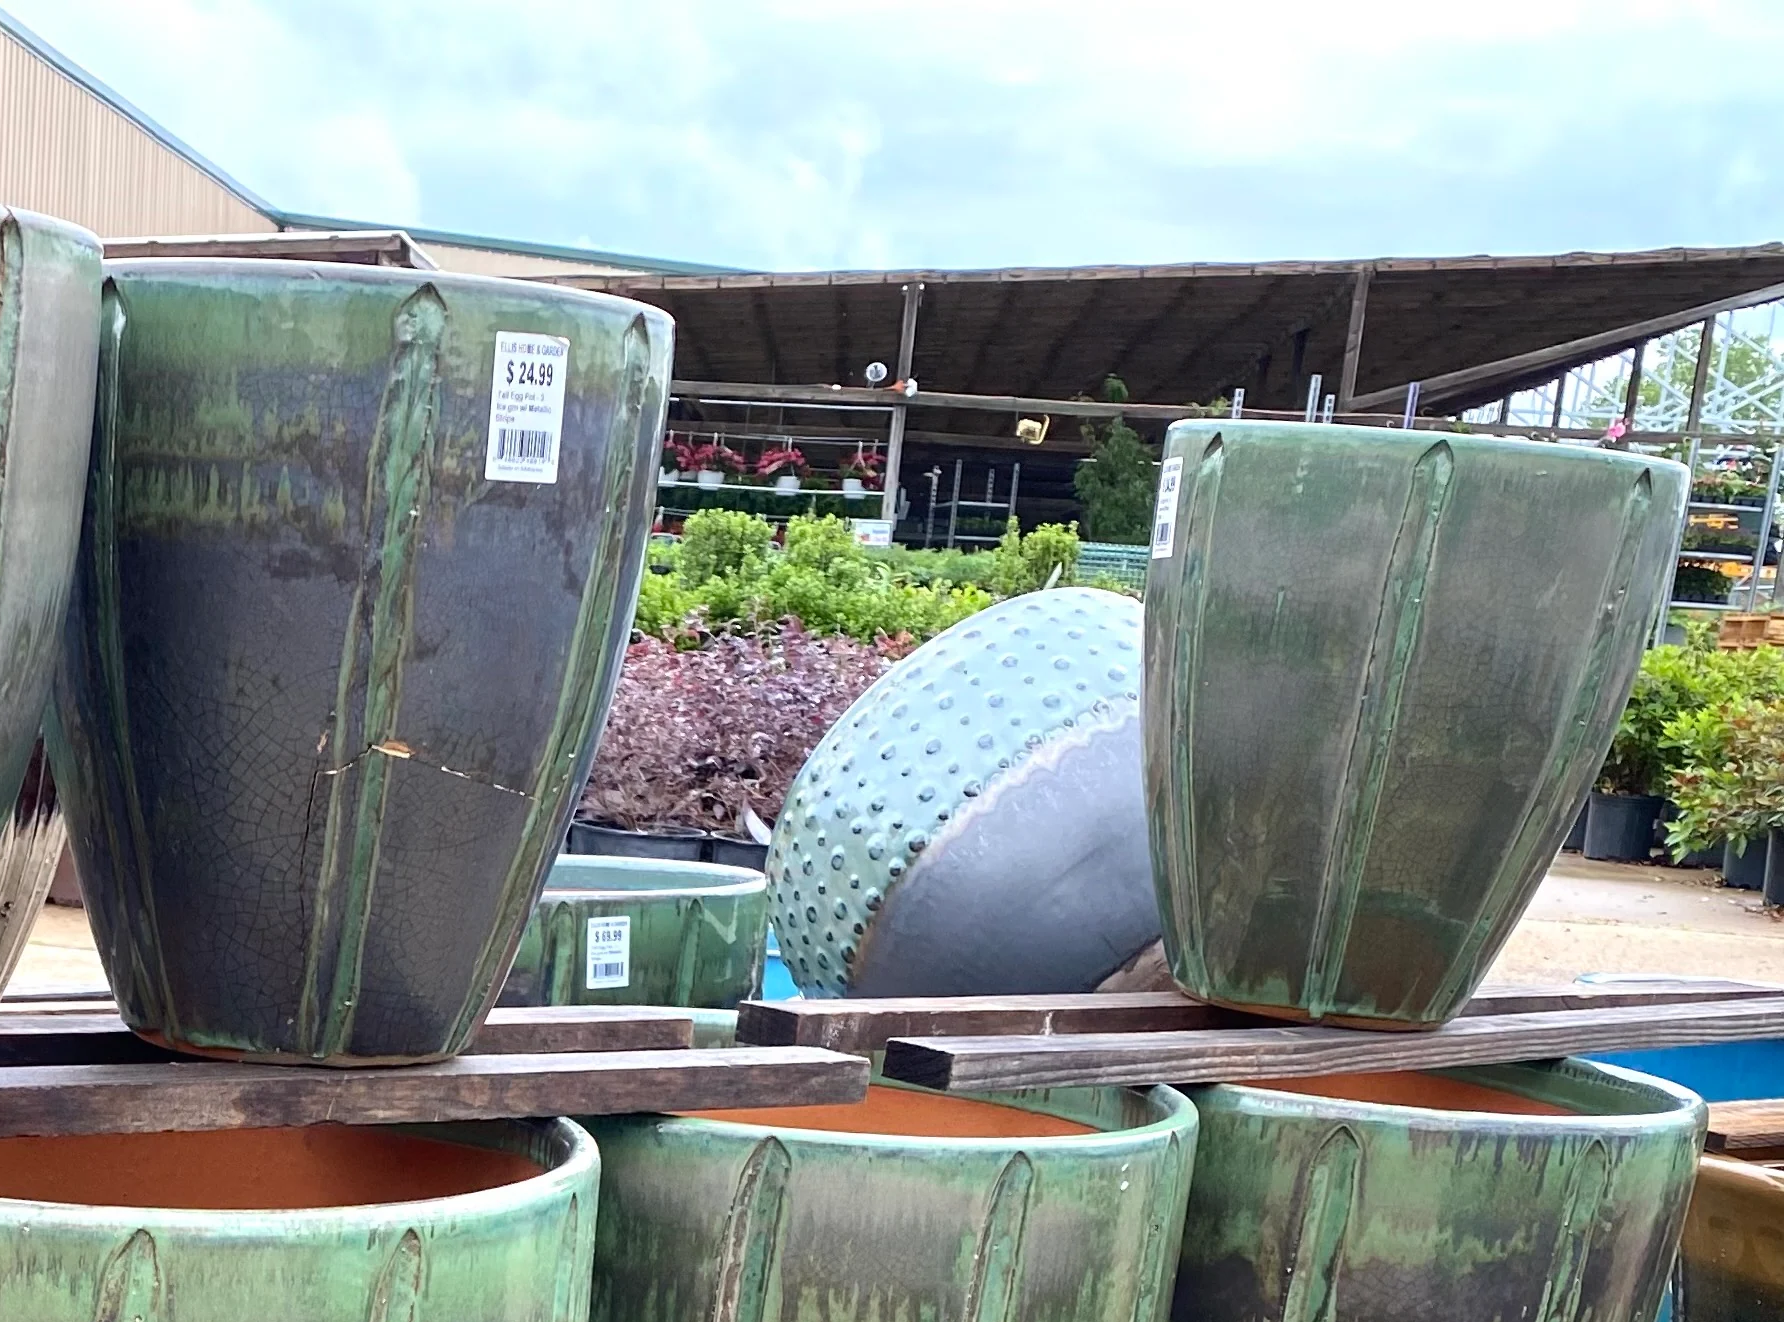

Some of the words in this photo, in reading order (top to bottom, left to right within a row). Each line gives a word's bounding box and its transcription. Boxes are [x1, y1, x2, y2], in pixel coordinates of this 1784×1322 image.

[500, 341, 517, 353] ELLIS
[518, 343, 535, 354] HOME
[506, 359, 514, 386] $
[519, 361, 553, 386] 24.99
[511, 391, 523, 402] Egg
